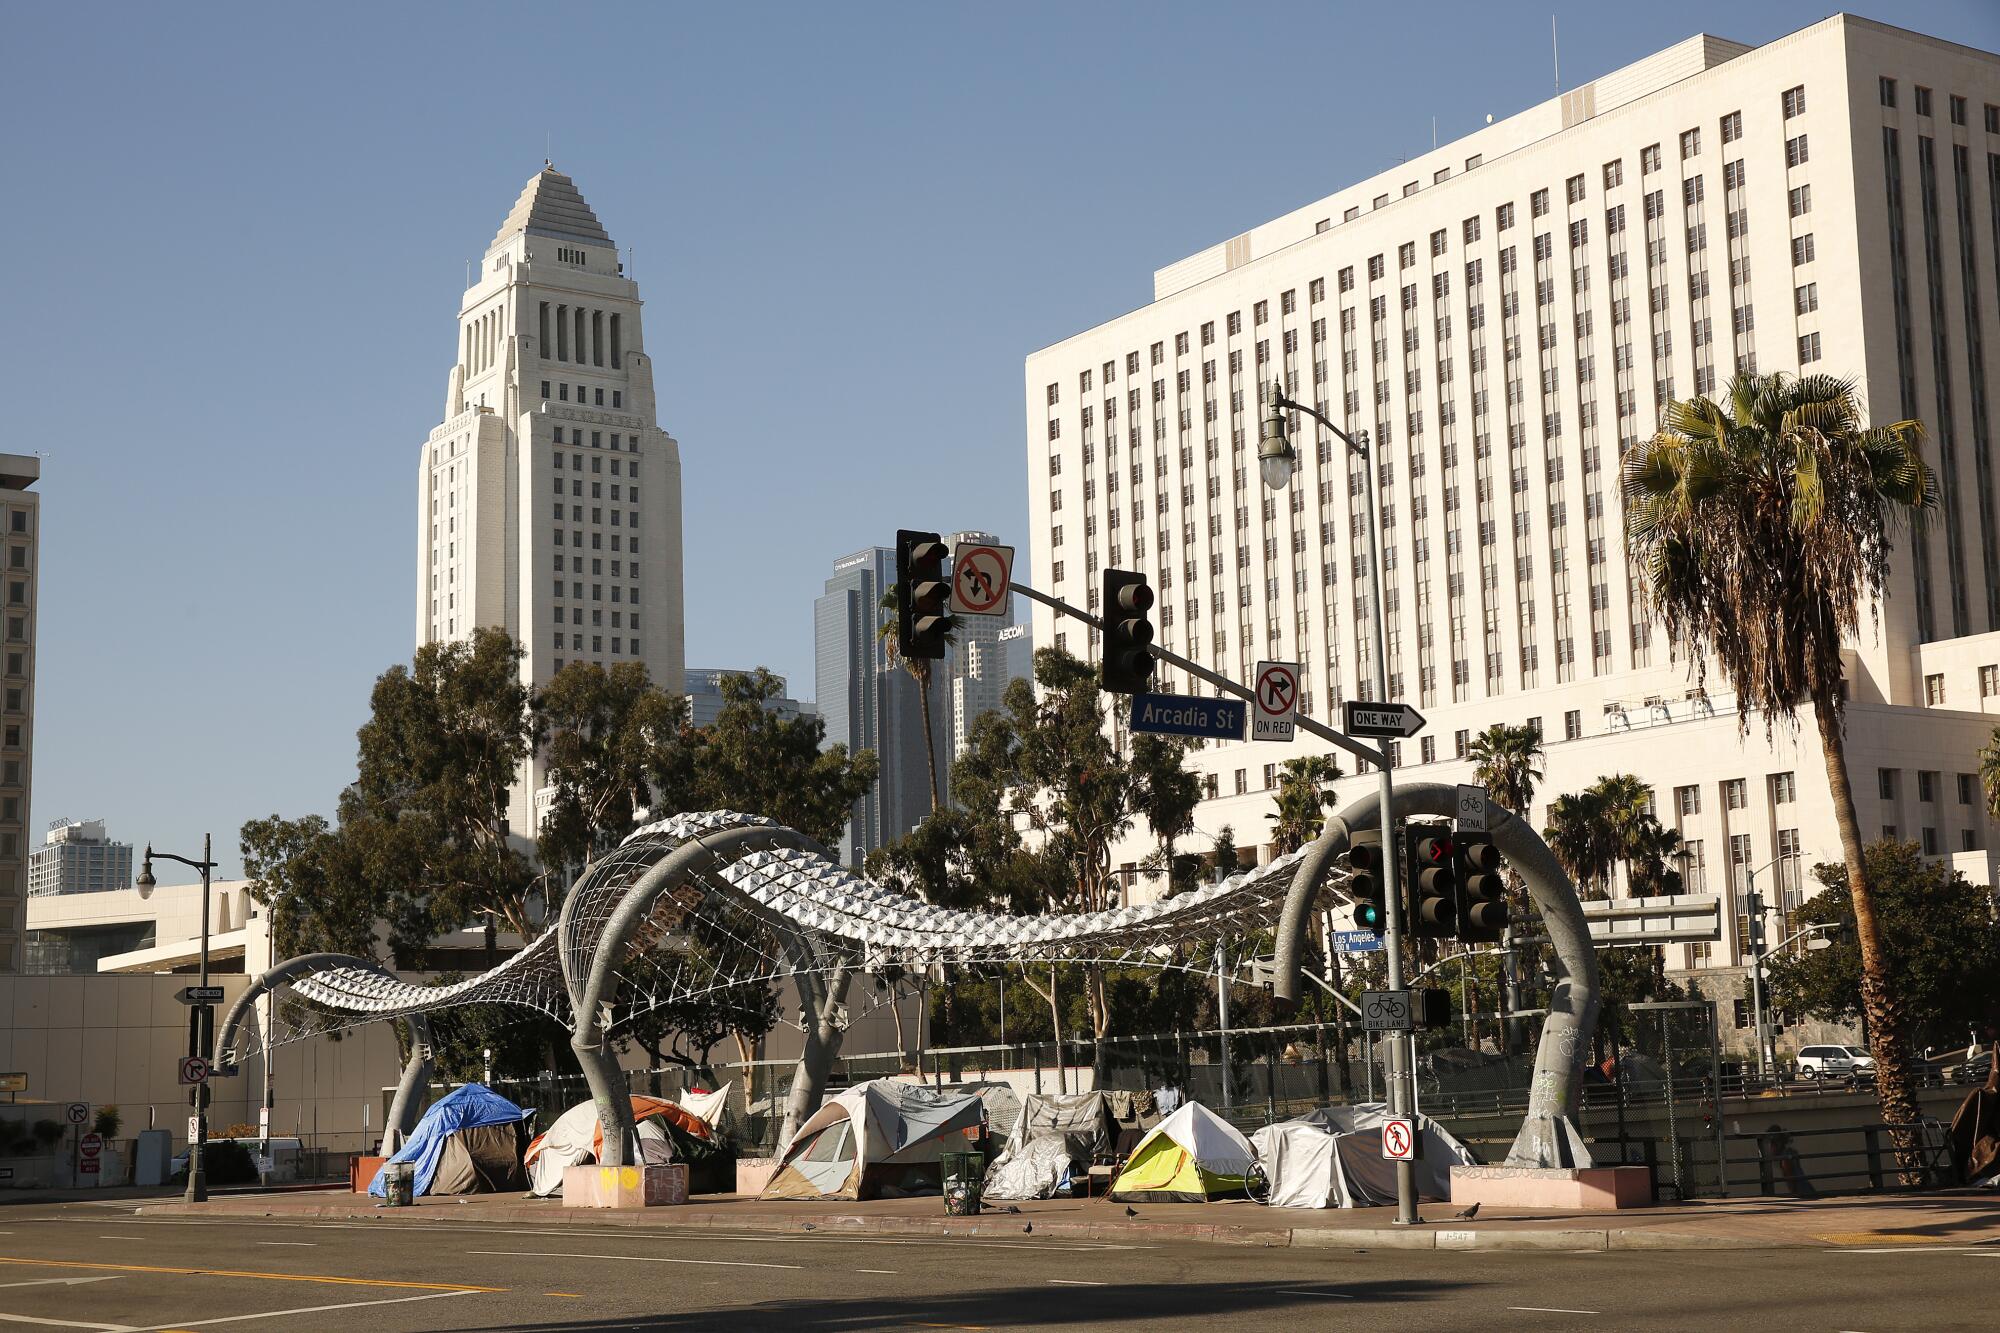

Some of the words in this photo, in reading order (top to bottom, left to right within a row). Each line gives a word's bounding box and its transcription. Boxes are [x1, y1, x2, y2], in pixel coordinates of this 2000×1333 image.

[998, 624, 1024, 641] AECOM
[1142, 703, 1208, 728] Arcadia
[1215, 710, 1235, 730] St
[1356, 712, 1378, 726] ONE
[1381, 713, 1403, 727] WAY
[1256, 720, 1271, 733] ON
[1272, 721, 1291, 734] RED
[1459, 817, 1485, 830] SIGNAL
[1334, 933, 1347, 944] Los
[1349, 932, 1376, 945] Angeles
[1334, 943, 1345, 951] 300
[1377, 941, 1383, 949] St
[1368, 1019, 1385, 1029] BIKE
[1387, 1018, 1406, 1028] LANE
